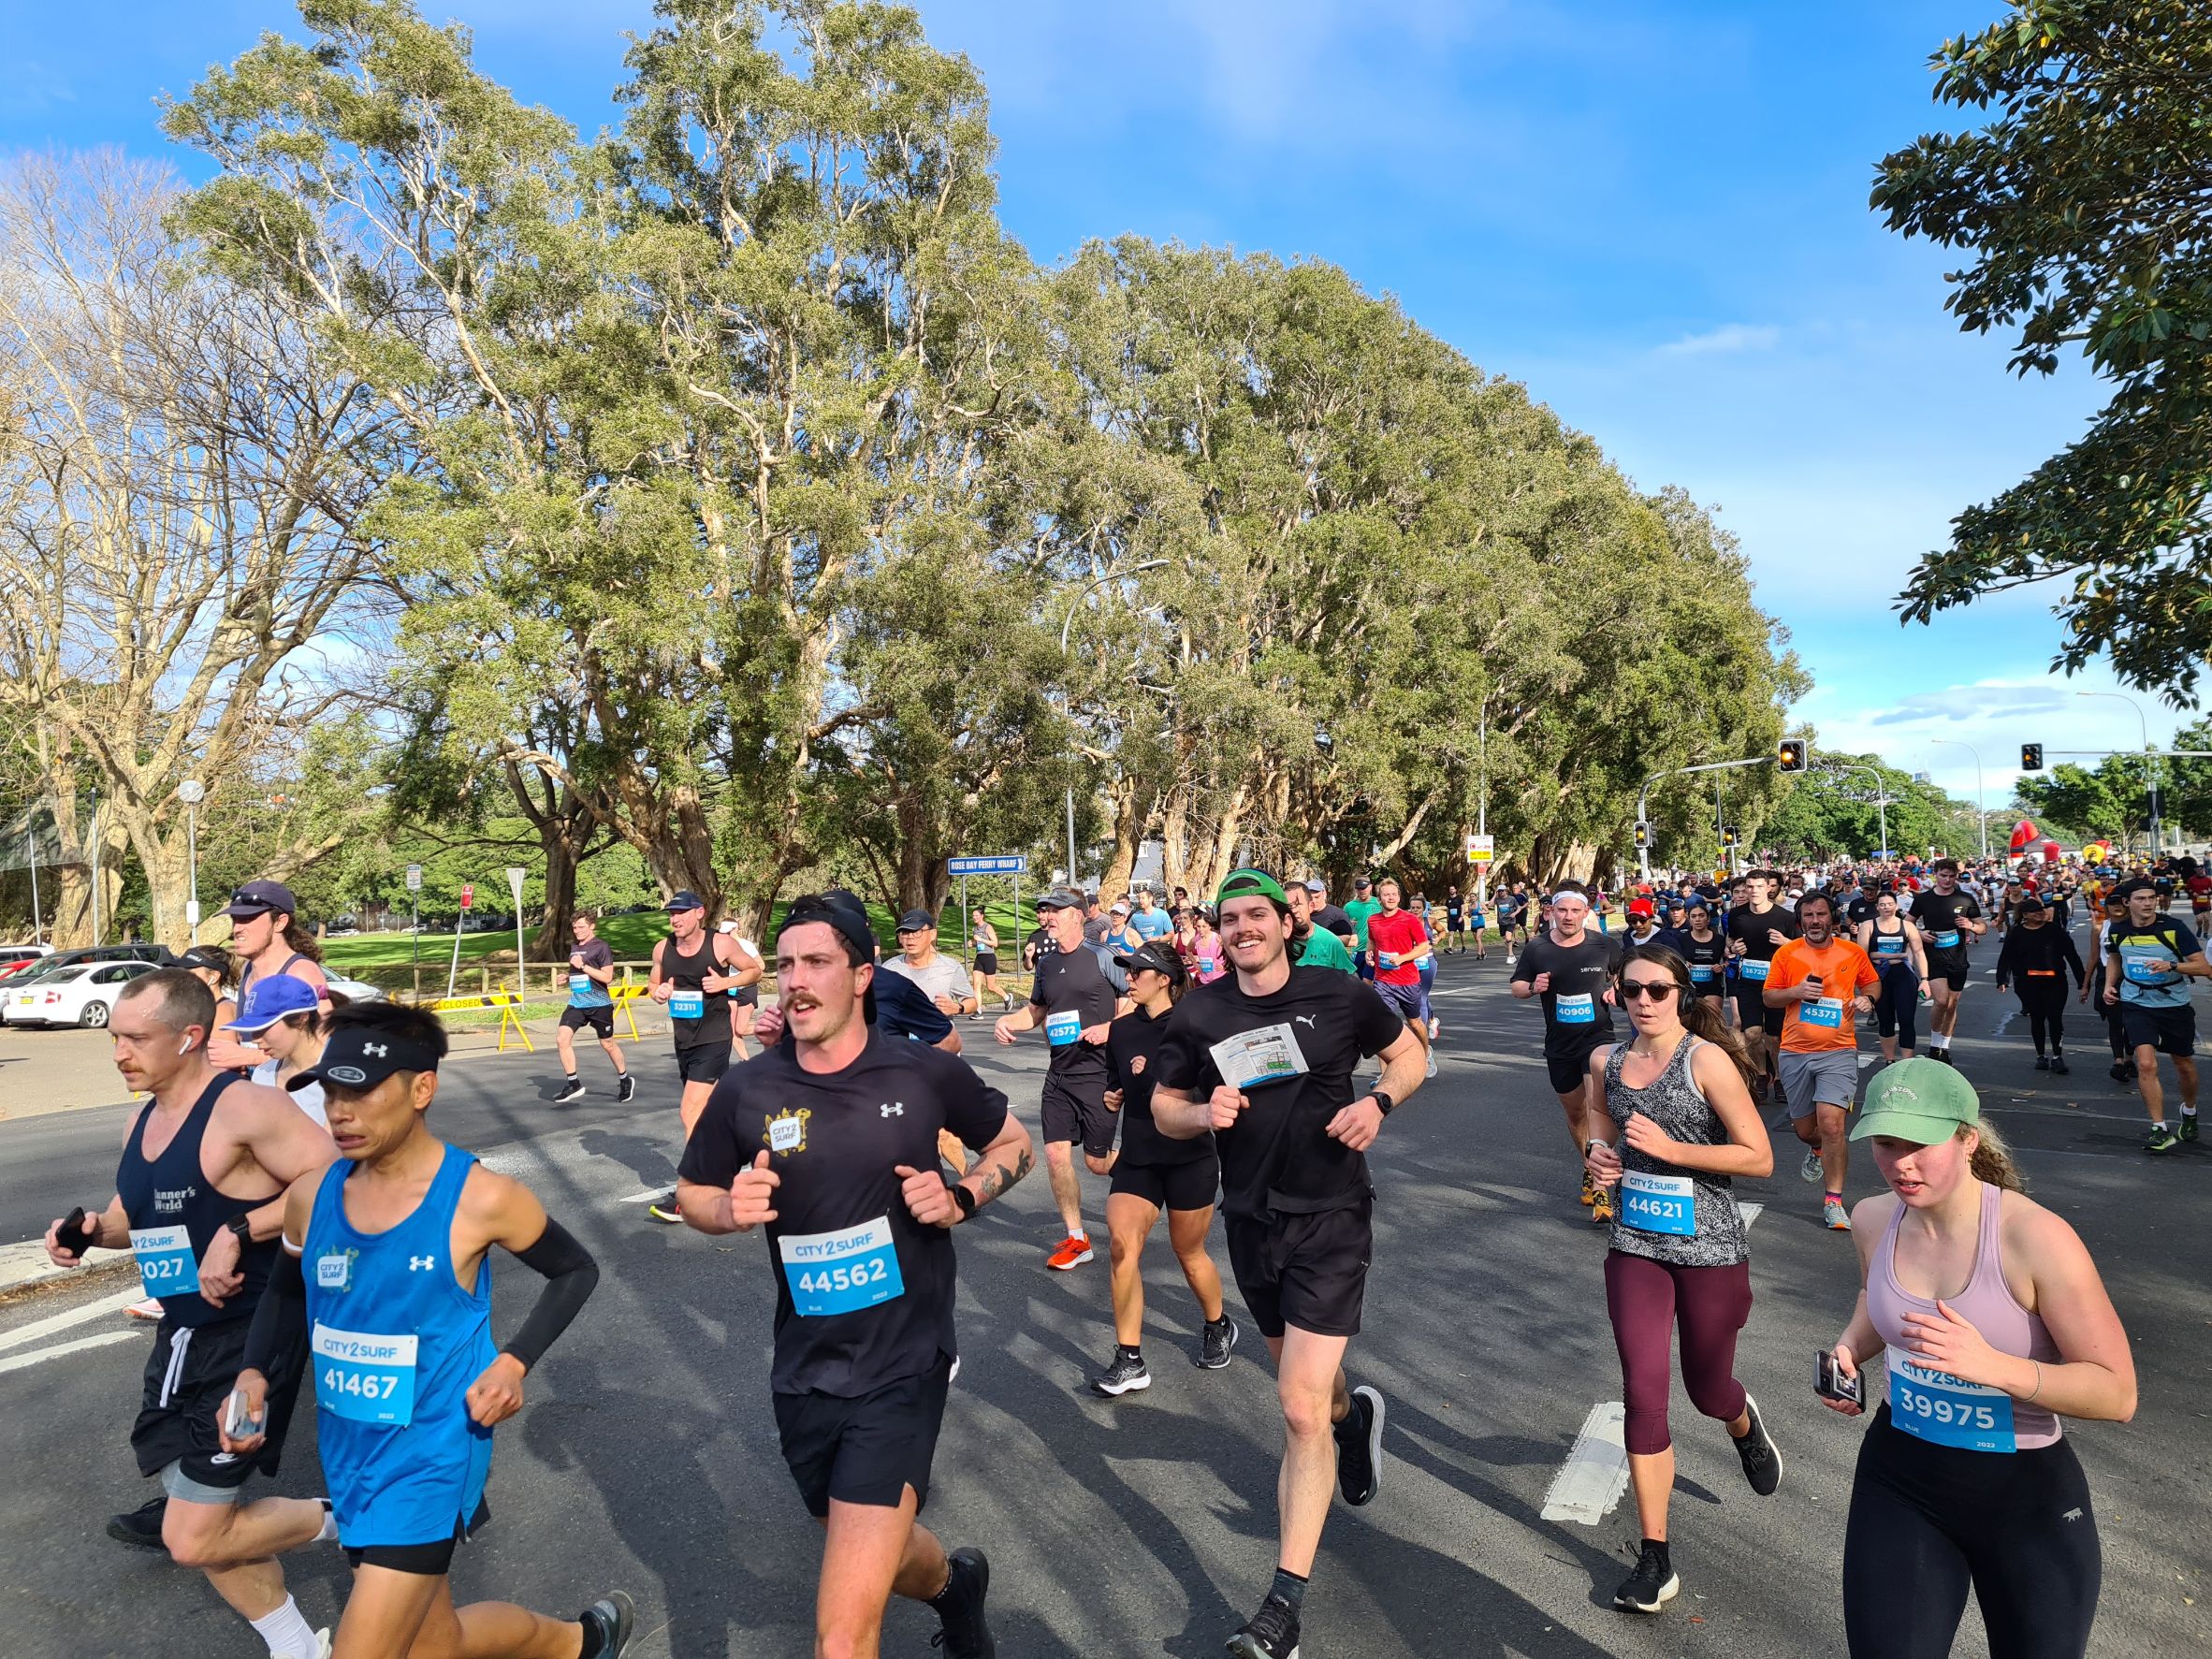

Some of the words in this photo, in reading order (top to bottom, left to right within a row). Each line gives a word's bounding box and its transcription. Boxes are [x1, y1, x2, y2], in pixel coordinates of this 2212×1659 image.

[951, 861, 966, 870] ROSE
[966, 860, 978, 869] BAY
[978, 859, 997, 869] FERRY
[997, 859, 1017, 868] WHARF
[443, 998, 480, 1010] CLOSED
[674, 1002, 696, 1011] 32311
[1559, 1006, 1592, 1016] 40906
[1804, 1007, 1837, 1020] 45373
[1049, 1026, 1076, 1038] 42572
[775, 1132, 796, 1142] SURF
[1628, 1196, 1682, 1218] 44621
[321, 1271, 343, 1279] SURF
[798, 1258, 888, 1294] 44562
[324, 1367, 399, 1400] 41467
[1900, 1386, 1995, 1430] 39975
[1904, 1422, 1920, 1433] BLUE
